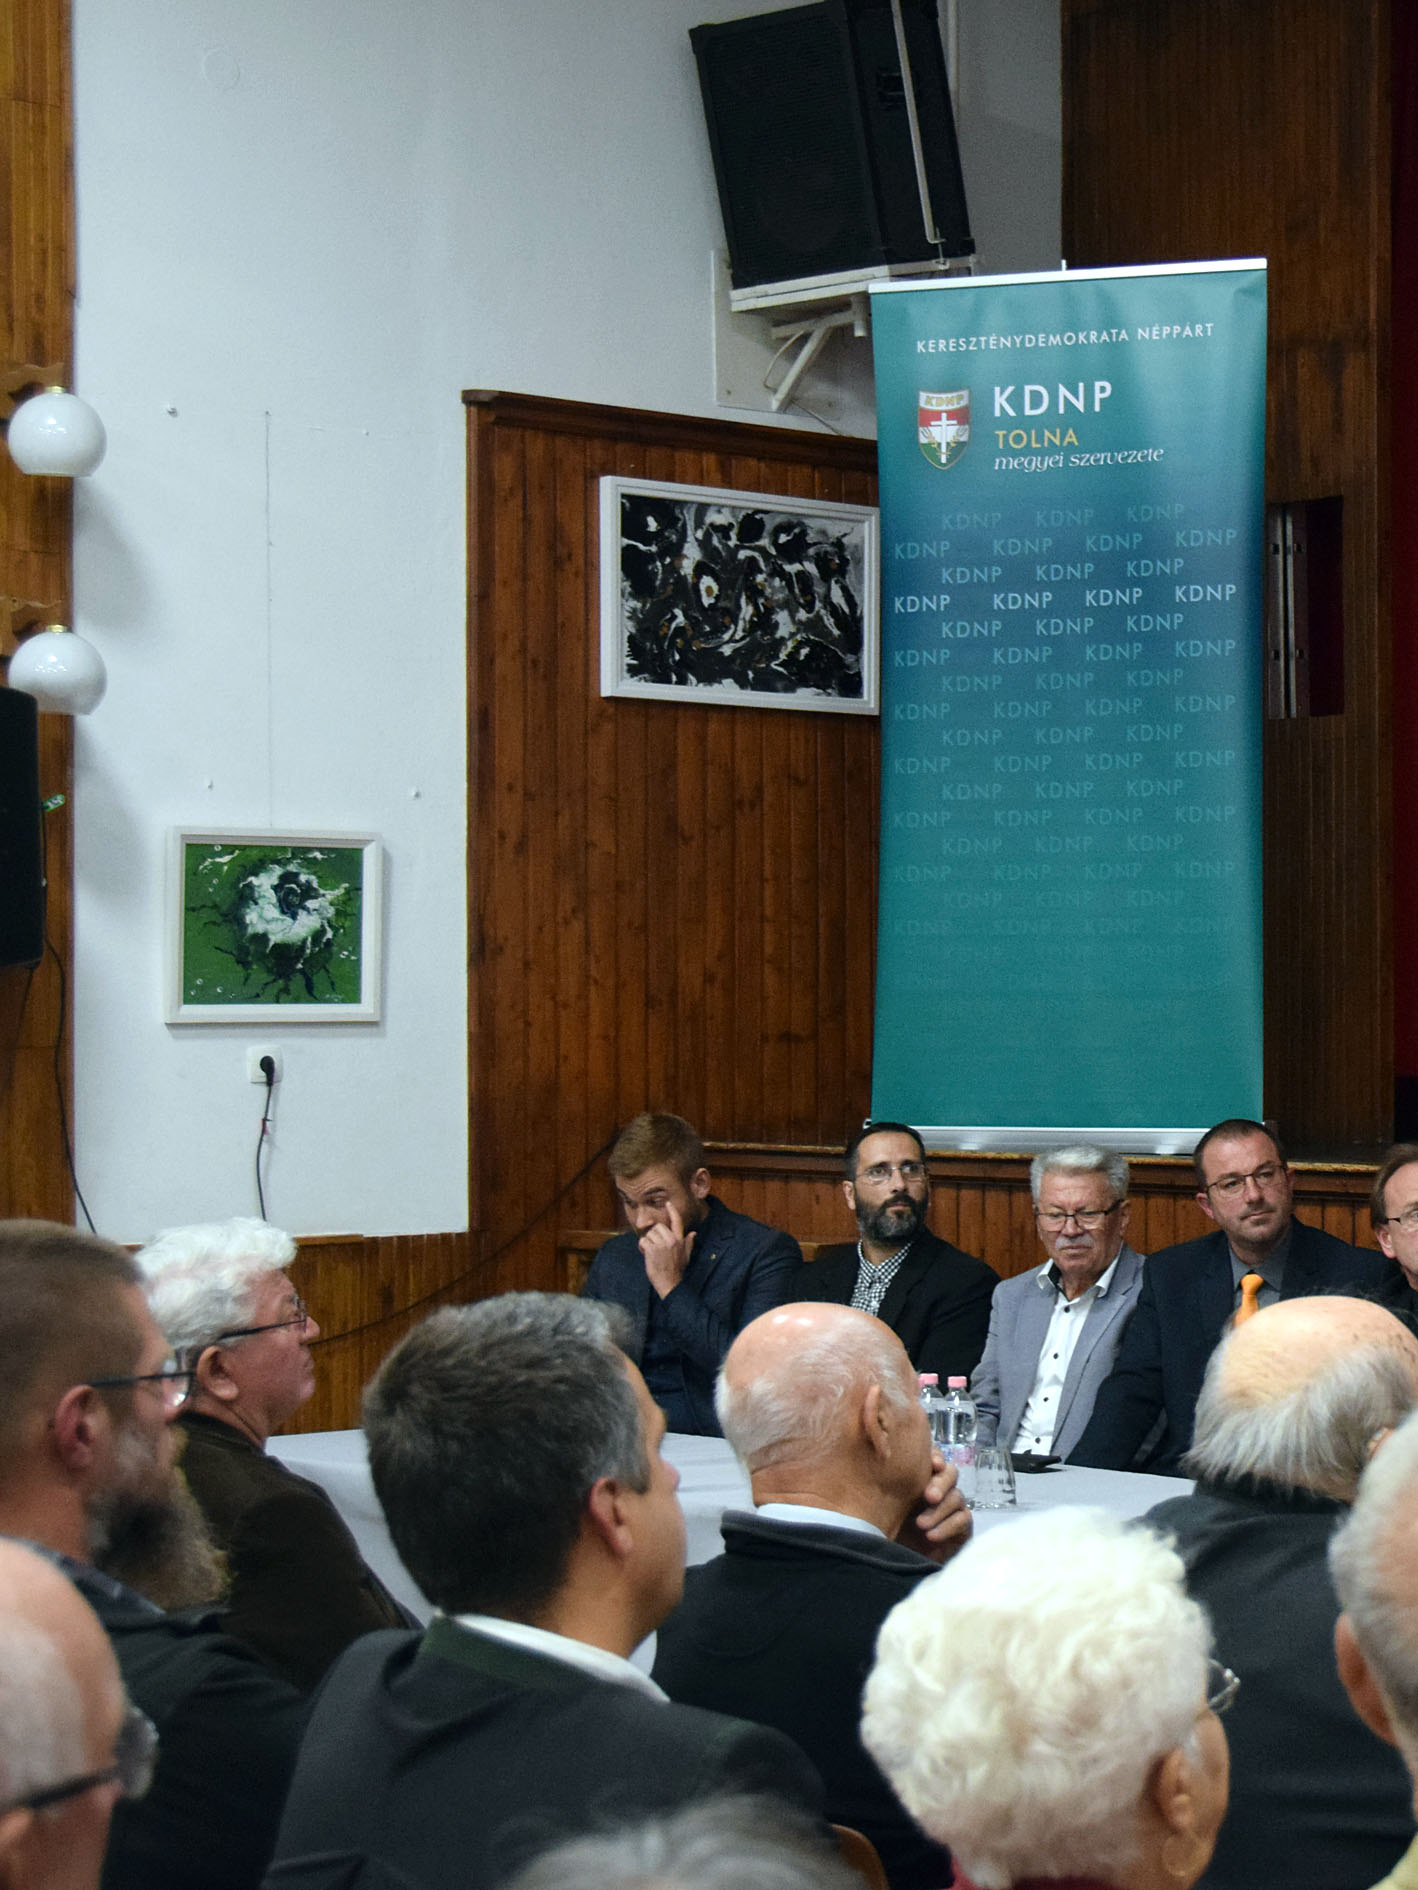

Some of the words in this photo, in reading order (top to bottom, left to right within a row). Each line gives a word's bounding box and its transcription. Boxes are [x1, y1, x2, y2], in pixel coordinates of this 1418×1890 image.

[916, 328, 1130, 353] KERESZTÉNYDEMOKRATA
[1137, 322, 1215, 342] NÉPPÁRT
[925, 393, 964, 407] KDNP
[993, 380, 1113, 418] KDNP
[994, 427, 1080, 450] TOLNA
[993, 451, 1065, 474] megyei
[1068, 446, 1165, 468] szervezete
[941, 512, 1001, 532] KDNP
[1035, 508, 1095, 528] KDNP
[1126, 503, 1185, 523] KDNP
[895, 541, 951, 560] KDNP
[993, 537, 1053, 556] KDNP
[1085, 533, 1143, 552] KDNP
[1175, 528, 1237, 548] KDNP
[941, 565, 1002, 585] KDNP
[1035, 561, 1095, 581] KDNP
[1126, 557, 1185, 578] KDNP
[894, 594, 951, 614] KDNP
[993, 590, 1053, 610] KDNP
[1085, 587, 1143, 607] KDNP
[1175, 583, 1237, 603] KDNP
[941, 620, 1002, 639] KDNP
[1035, 616, 1095, 636] KDNP
[1126, 612, 1184, 633] KDNP
[895, 648, 951, 667] KDNP
[993, 645, 1053, 665] KDNP
[1085, 642, 1143, 661] KDNP
[1175, 638, 1237, 658] KDNP
[941, 674, 1002, 693] KDNP
[1035, 671, 1095, 690] KDNP
[1126, 667, 1184, 687] KDNP
[895, 702, 951, 721] KDNP
[993, 699, 1052, 719] KDNP
[1085, 697, 1143, 716] KDNP
[1175, 693, 1237, 713] KDNP
[941, 728, 1002, 747] KDNP
[1035, 725, 1094, 744] KDNP
[1126, 722, 1184, 742] KDNP
[895, 756, 951, 775] KDNP
[993, 754, 1052, 773] KDNP
[1085, 751, 1143, 771] KDNP
[1175, 748, 1237, 768] KDNP
[941, 782, 1002, 801] KDNP
[1035, 780, 1094, 799] KDNP
[1126, 778, 1184, 797] KDNP
